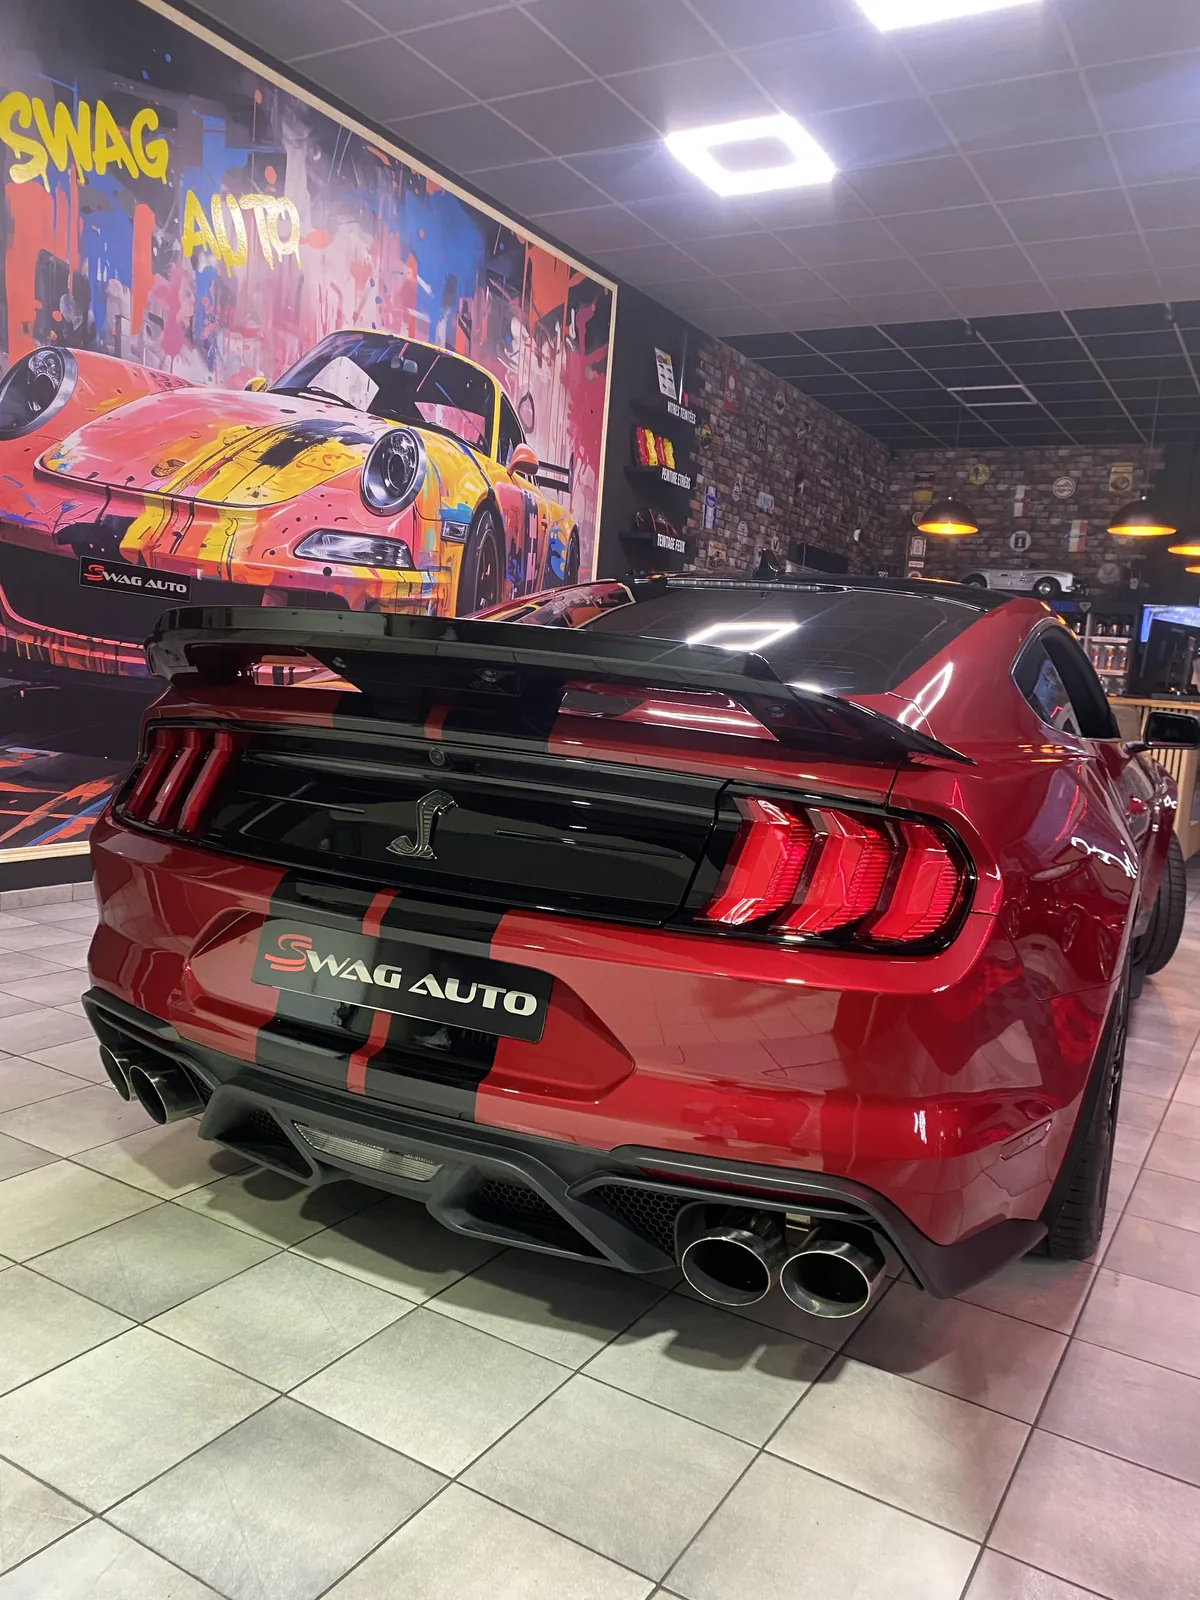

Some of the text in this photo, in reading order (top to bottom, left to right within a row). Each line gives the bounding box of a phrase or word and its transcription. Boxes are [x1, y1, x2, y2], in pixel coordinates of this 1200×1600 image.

[0, 91, 169, 190] SWAG
[181, 189, 302, 272] AUTO
[667, 400, 680, 417] VITRES
[661, 467, 678, 485] PEINTURE
[657, 533, 686, 553] TEINTAGE FEUX
[83, 564, 187, 593] SWAG AUTO
[264, 933, 538, 1017] SWAG AUTO
